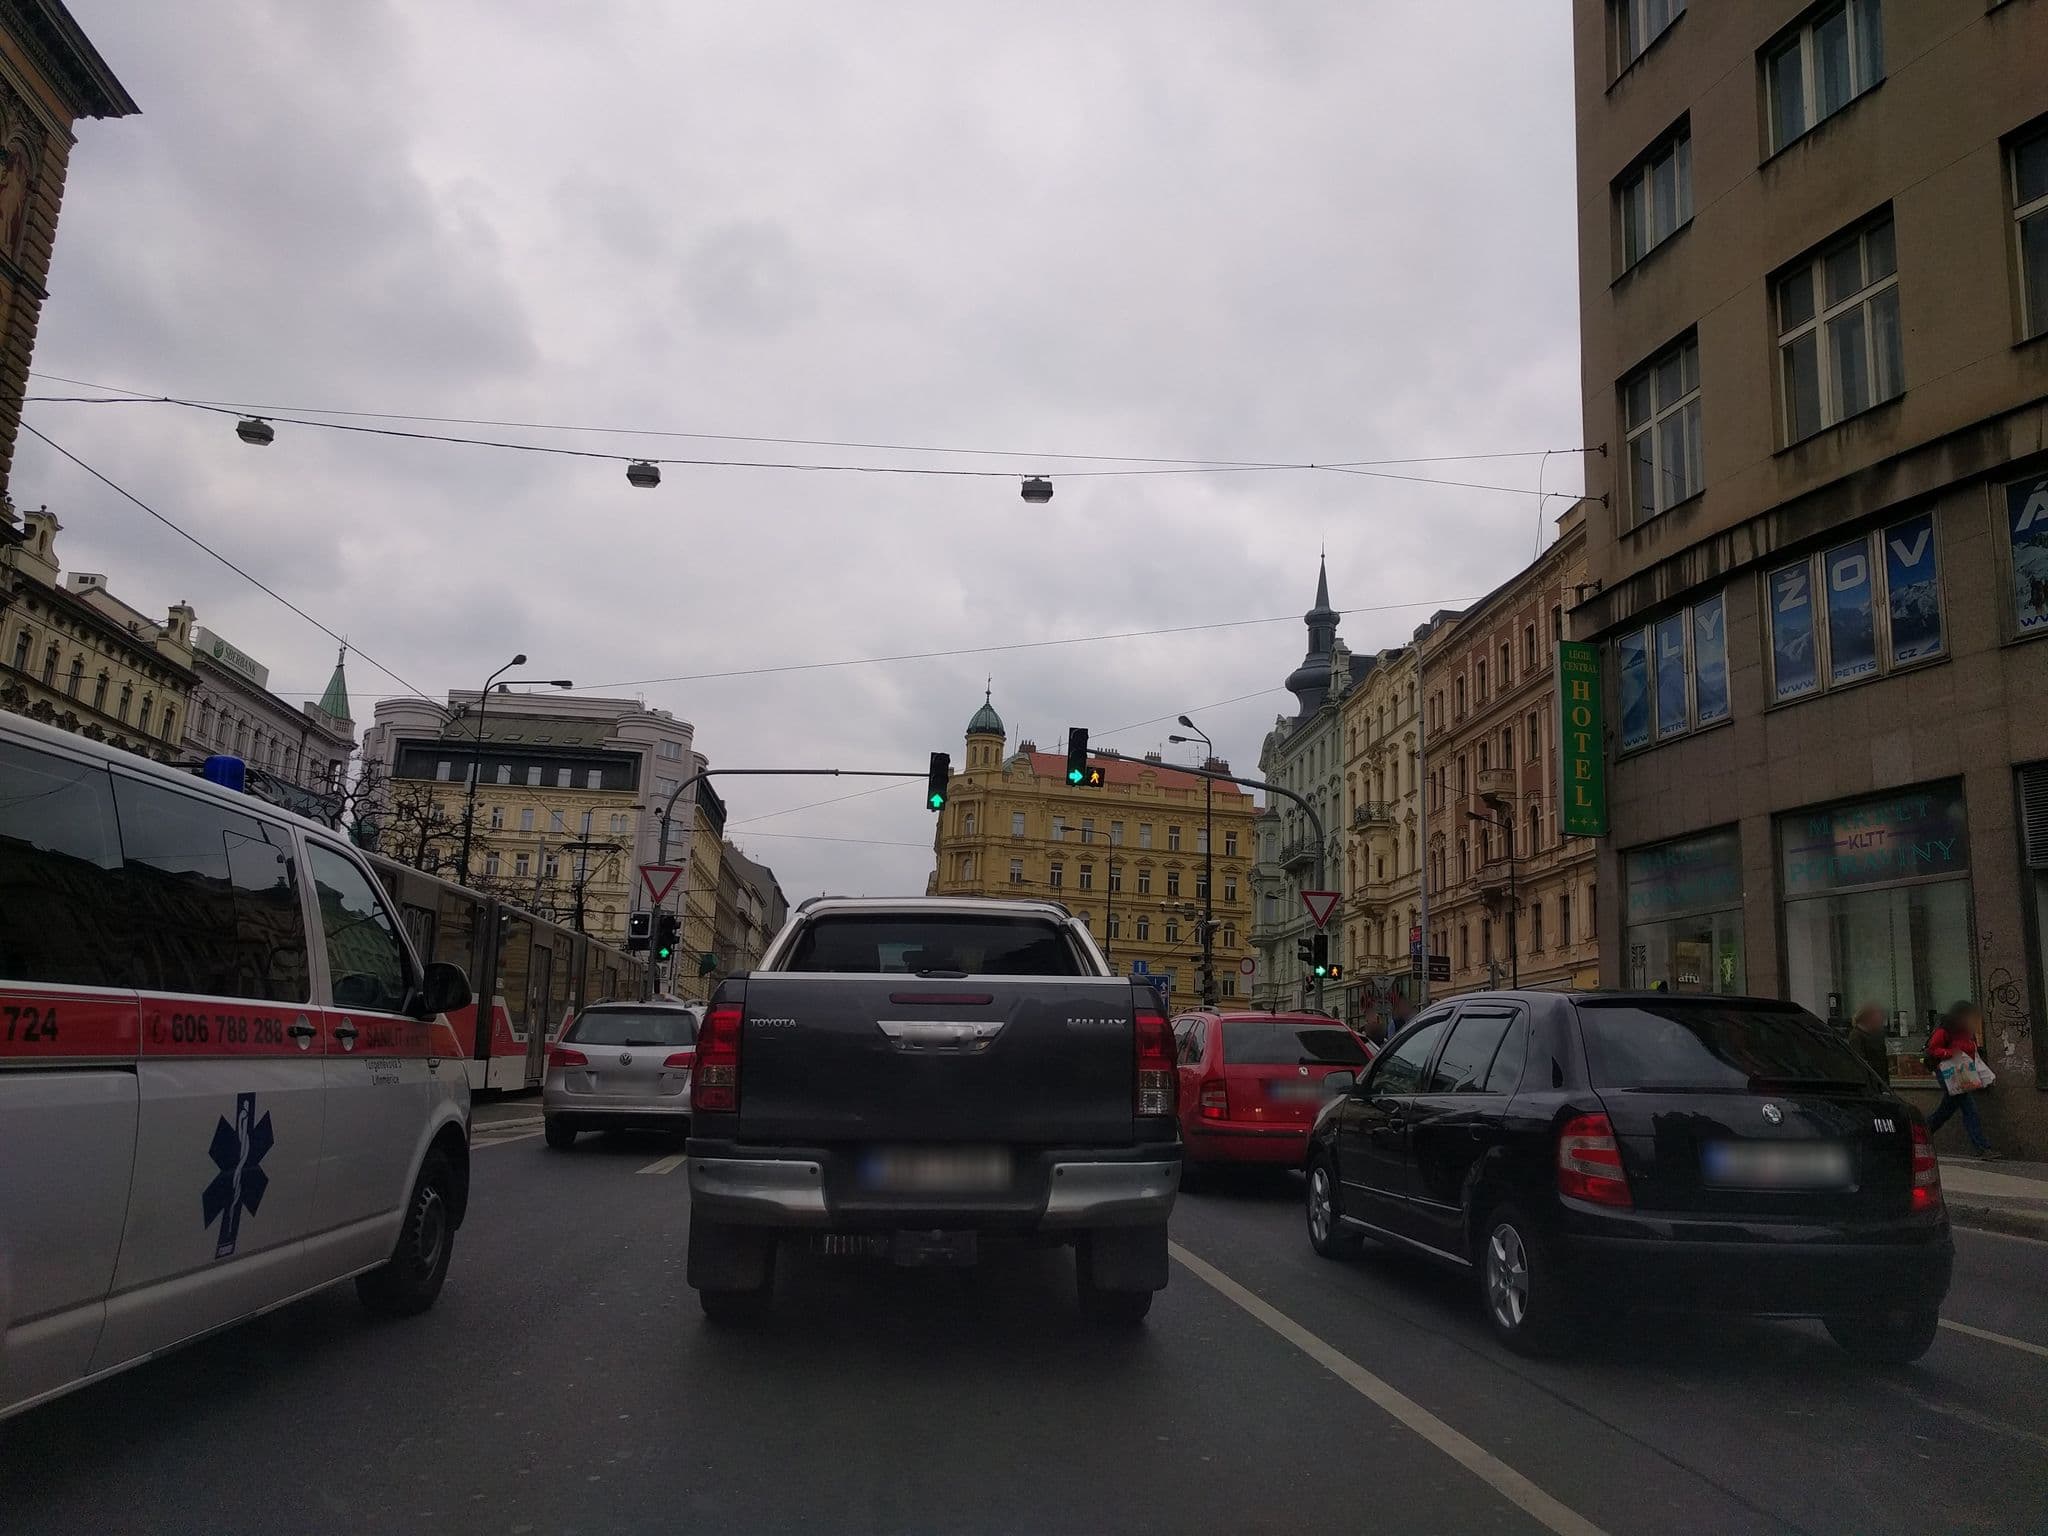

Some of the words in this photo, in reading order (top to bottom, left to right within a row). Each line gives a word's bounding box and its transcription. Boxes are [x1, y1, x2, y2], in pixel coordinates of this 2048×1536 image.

[1834, 660, 1876, 679] PETRS
[1571, 679, 1592, 807] HOTEL
[3, 1006, 58, 1041] 724
[172, 1013, 208, 1042] 606
[215, 1014, 247, 1042] 788
[254, 1016, 283, 1043] 288
[750, 1018, 797, 1028] TOYOTA
